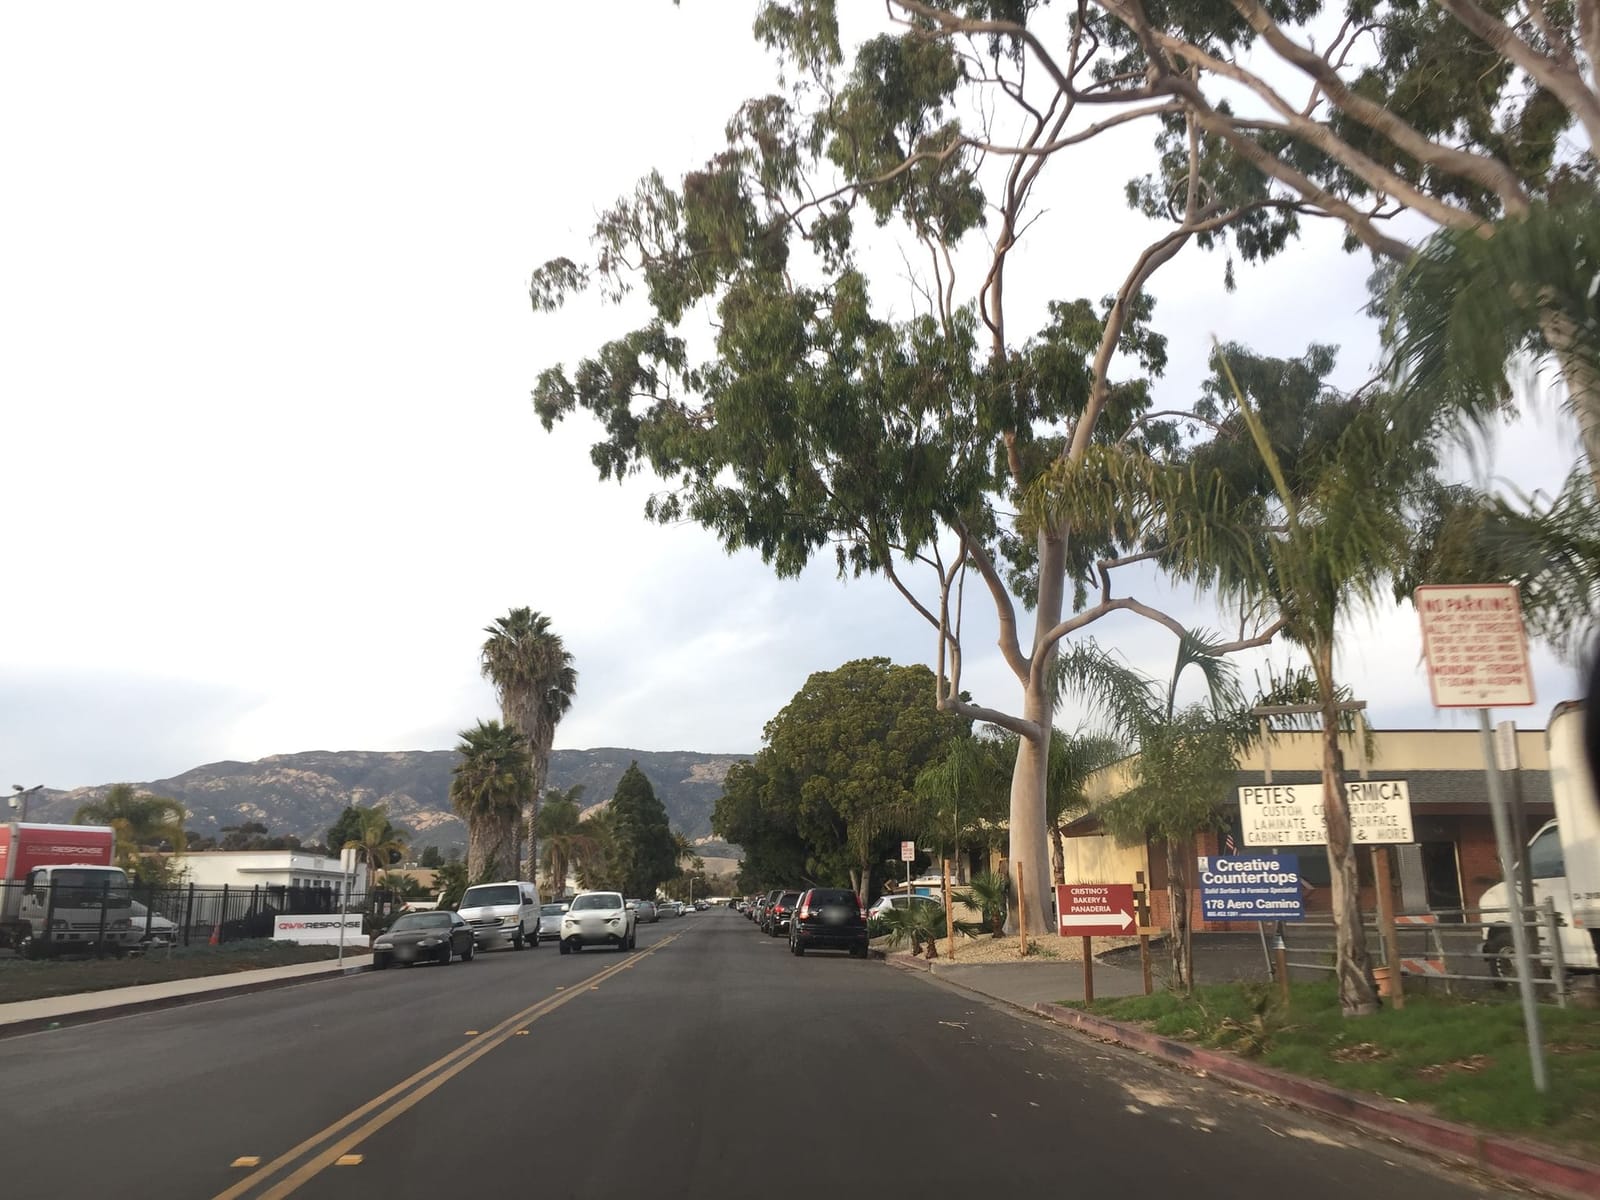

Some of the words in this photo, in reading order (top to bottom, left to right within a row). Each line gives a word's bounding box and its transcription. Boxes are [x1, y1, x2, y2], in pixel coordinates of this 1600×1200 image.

[1446, 597, 1514, 613] PARKING
[1243, 786, 1296, 805] PETE'S
[1347, 783, 1403, 801] RMICA
[1262, 805, 1303, 817] CUSTOM
[1253, 818, 1307, 830] LAMINATE
[1248, 831, 1291, 843] CABINET
[1355, 829, 1368, 841] &
[1377, 827, 1408, 840] MORE
[1216, 858, 1280, 872] Creative
[1202, 872, 1298, 886] Countertops
[1070, 887, 1109, 895] CRISTINO'S
[1070, 905, 1111, 913] PANADERIA
[1205, 899, 1225, 909] 178
[1227, 899, 1253, 909] Aero
[1256, 898, 1301, 909] Camino
